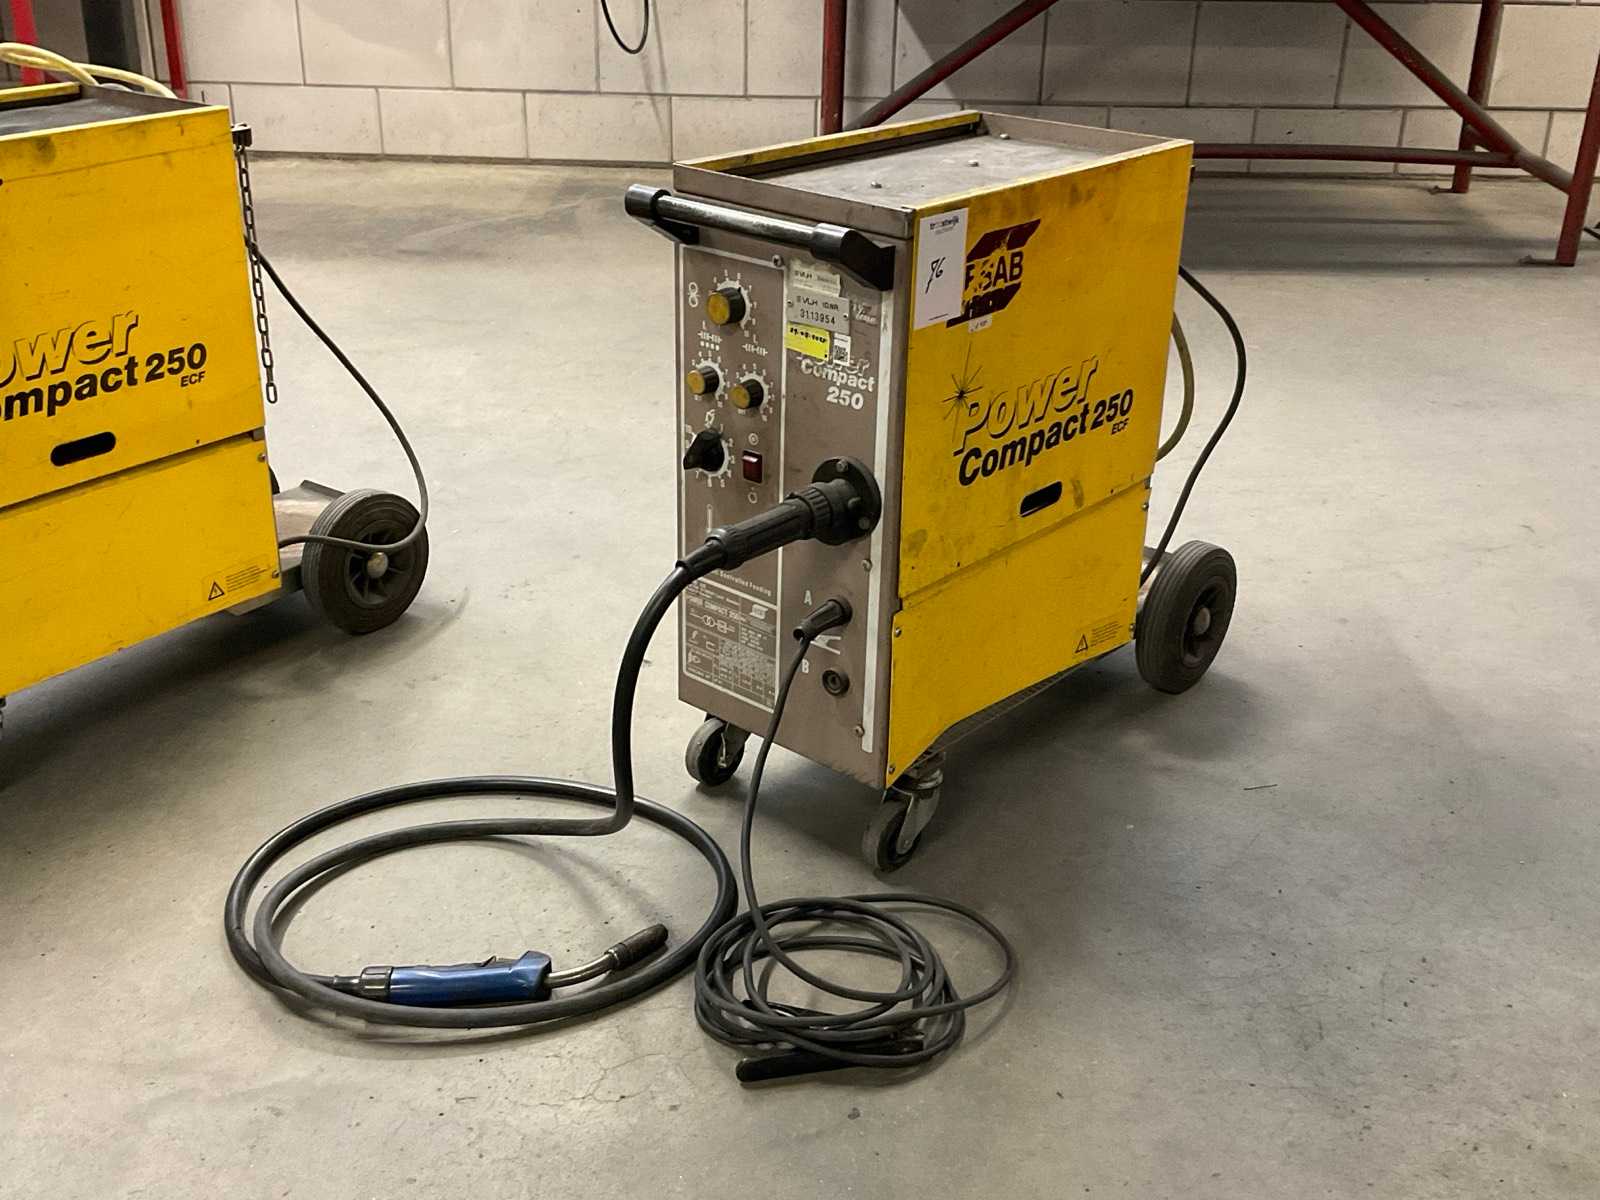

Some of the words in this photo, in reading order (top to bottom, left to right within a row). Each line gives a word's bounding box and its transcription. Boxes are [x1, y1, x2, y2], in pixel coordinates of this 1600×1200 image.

[0, 356, 139, 421] mpact
[145, 342, 207, 383] 250
[180, 371, 206, 388] ECF
[800, 359, 875, 392] Compact
[826, 386, 864, 410] 250
[953, 354, 1099, 457] Power
[959, 402, 1090, 486] Compact
[1090, 388, 1134, 431] 250
[1111, 418, 1130, 436] ECF
[803, 590, 813, 606] A
[801, 659, 810, 674] B
